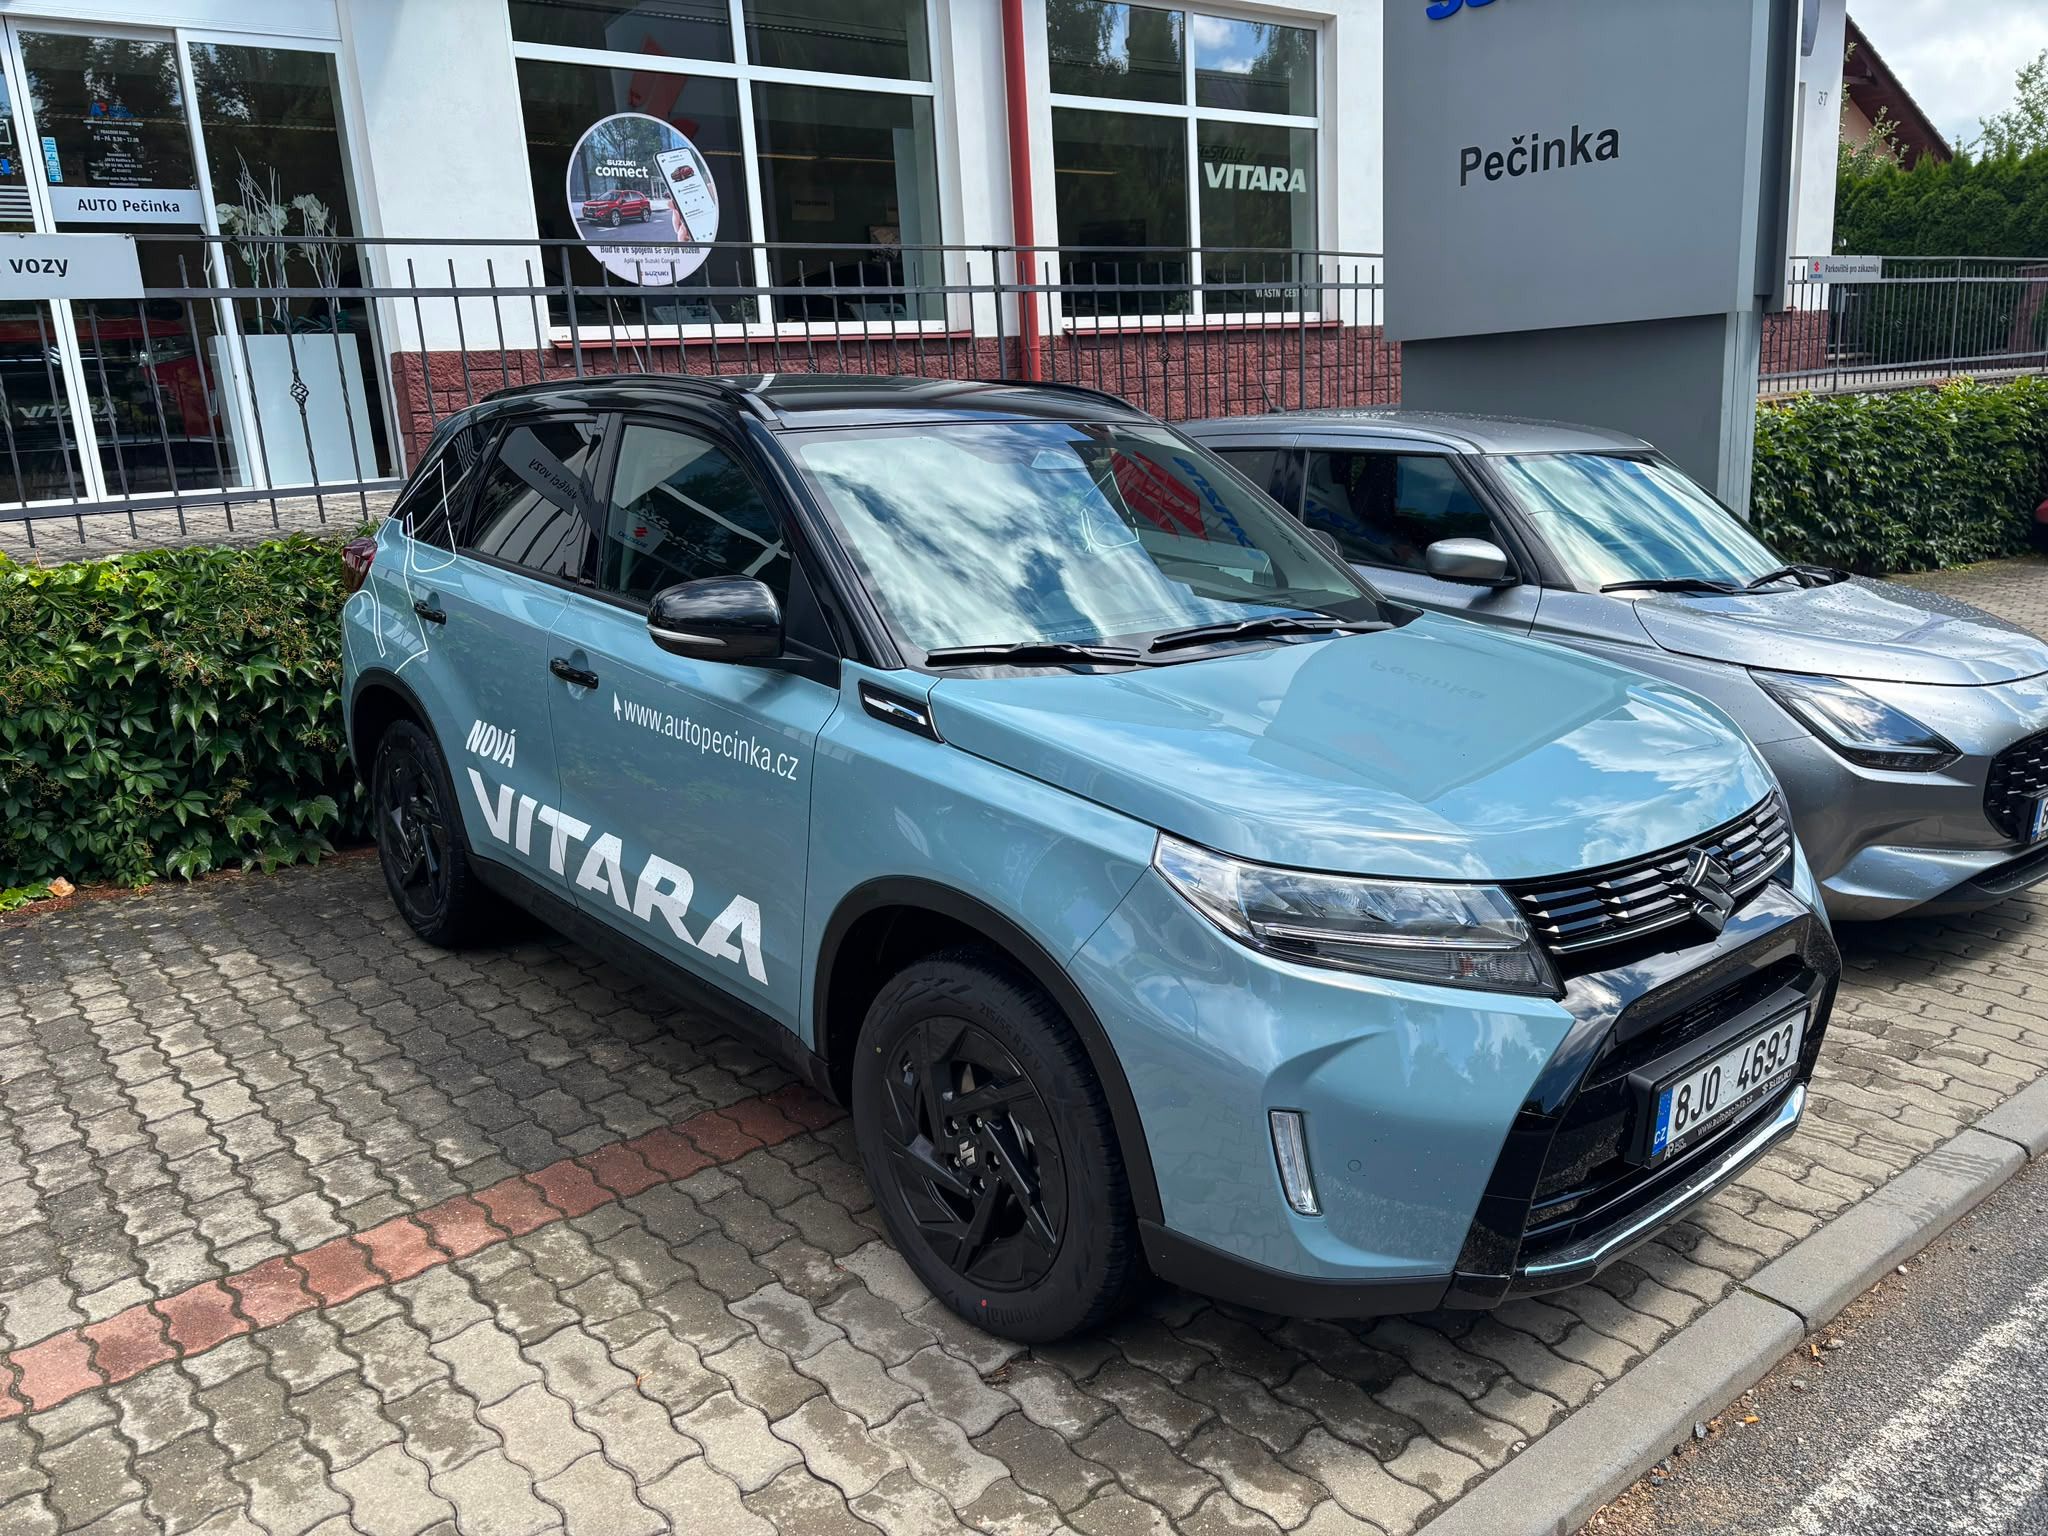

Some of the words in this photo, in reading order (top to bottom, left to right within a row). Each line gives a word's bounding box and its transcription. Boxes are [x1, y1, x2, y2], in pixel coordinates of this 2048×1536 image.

[607, 159, 636, 167] SUZUKI
[1460, 125, 1619, 187] Pečinka
[595, 166, 649, 178] connect
[1204, 162, 1306, 192] VITARA
[78, 199, 117, 212] AUTO
[122, 200, 180, 213] Pečinka
[9, 258, 67, 277] vozy
[465, 719, 517, 768] NOVÁ
[624, 700, 799, 781] www.autopecinka.cz
[467, 767, 768, 986] VITARA
[1737, 1023, 1794, 1091] 4693
[1654, 1127, 1667, 1142] CZ
